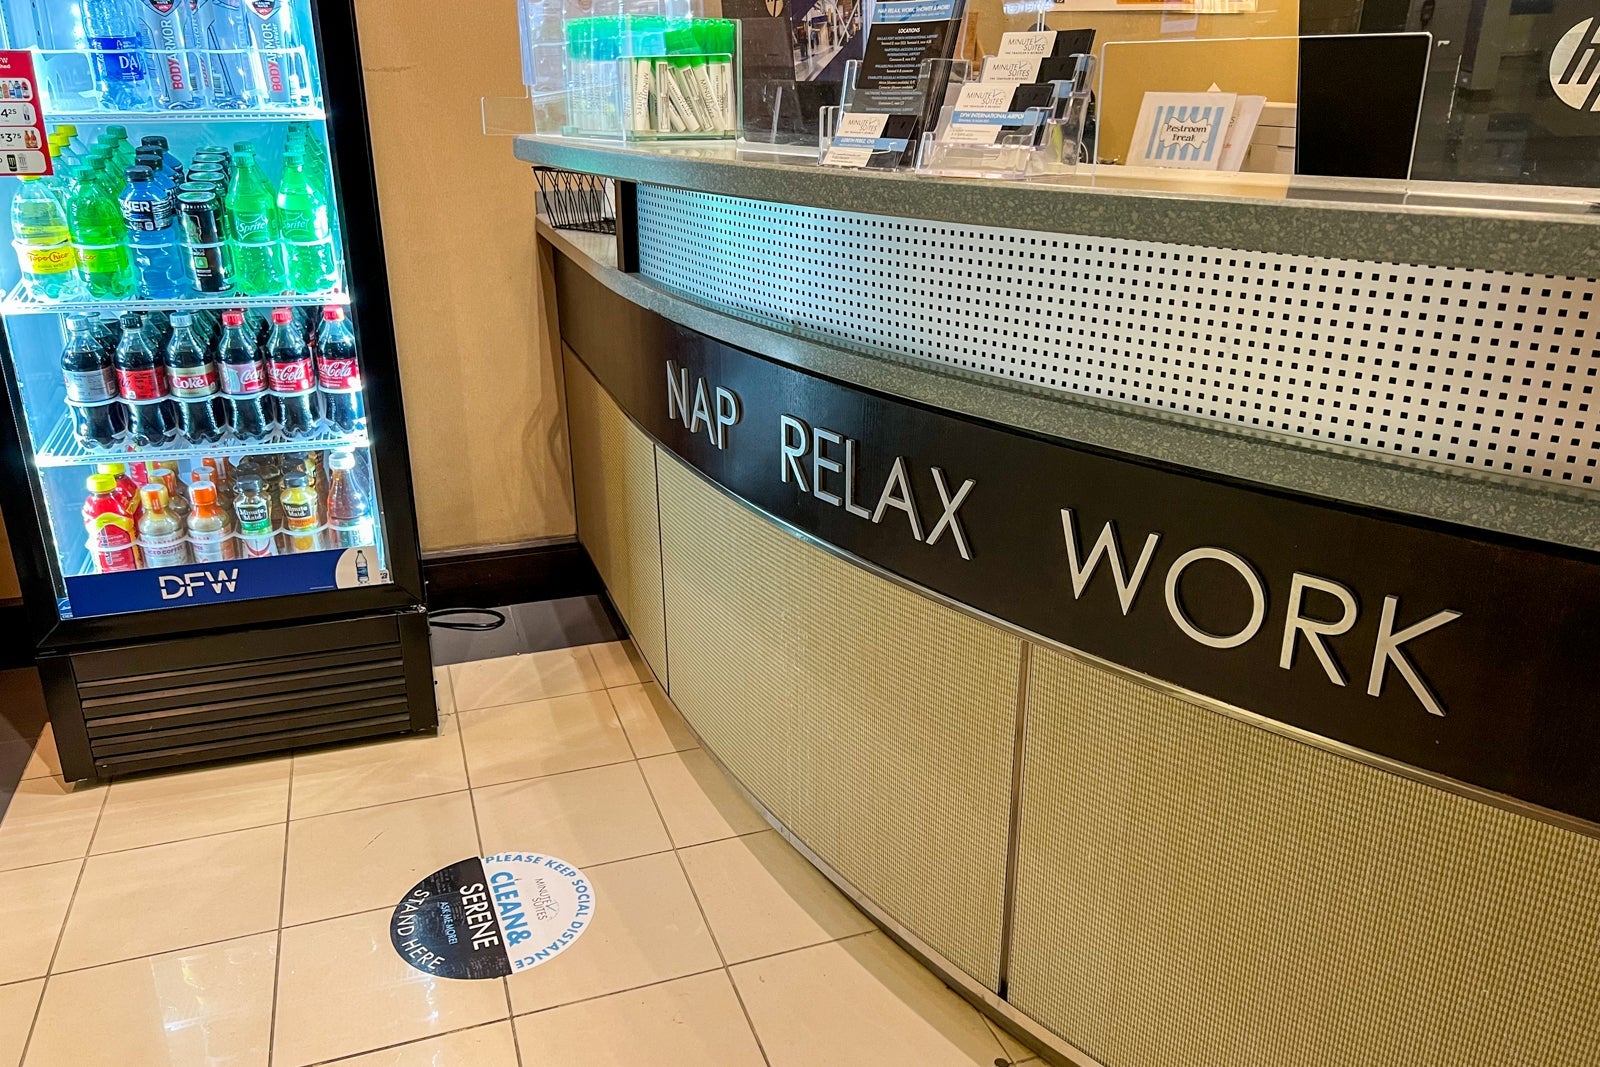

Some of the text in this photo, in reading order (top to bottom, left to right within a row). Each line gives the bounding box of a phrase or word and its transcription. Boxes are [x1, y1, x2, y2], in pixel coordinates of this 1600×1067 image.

[1007, 38, 1035, 46] MINUTE
[1023, 43, 1046, 52] SUITES
[992, 63, 1019, 71] MINUTE
[1007, 69, 1031, 77] SUITES
[966, 91, 993, 100] MINUTE
[981, 97, 1004, 106] SUITES
[238, 220, 267, 234] Sprite
[171, 376, 206, 389] Coke
[664, 359, 1463, 718] NAP RELAX WORK
[158, 568, 239, 600] DFW
[534, 877, 552, 906] MINUTE
[440, 901, 451, 914] ASK
[485, 854, 591, 970] PLEASE KEEP SOCIAL DISTANCE
[531, 896, 549, 922] SUITES
[443, 914, 454, 924] ME
[459, 881, 500, 951] SERENE
[396, 888, 446, 971] STAND HERE
